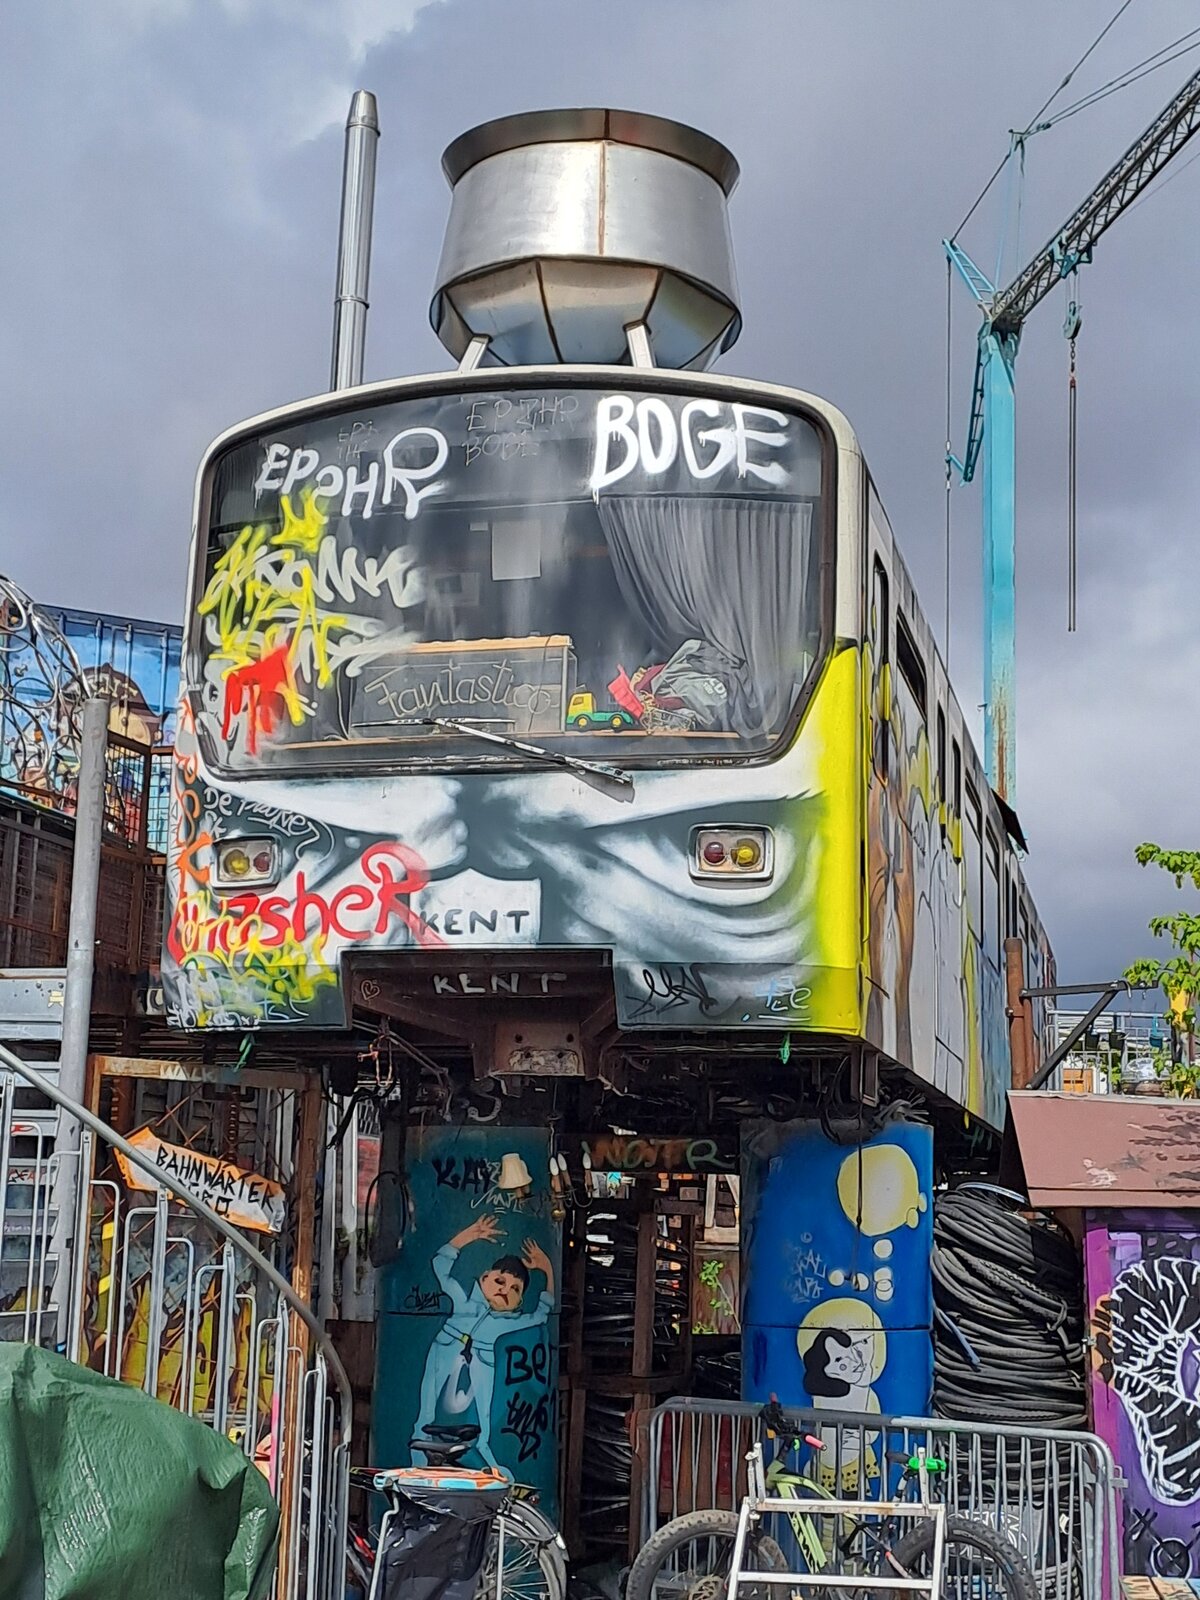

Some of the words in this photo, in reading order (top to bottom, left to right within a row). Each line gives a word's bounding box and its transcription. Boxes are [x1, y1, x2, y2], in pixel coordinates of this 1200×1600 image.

[591, 395, 793, 504] BOGE
[418, 908, 531, 936] KENT
[432, 972, 568, 995] KENT
